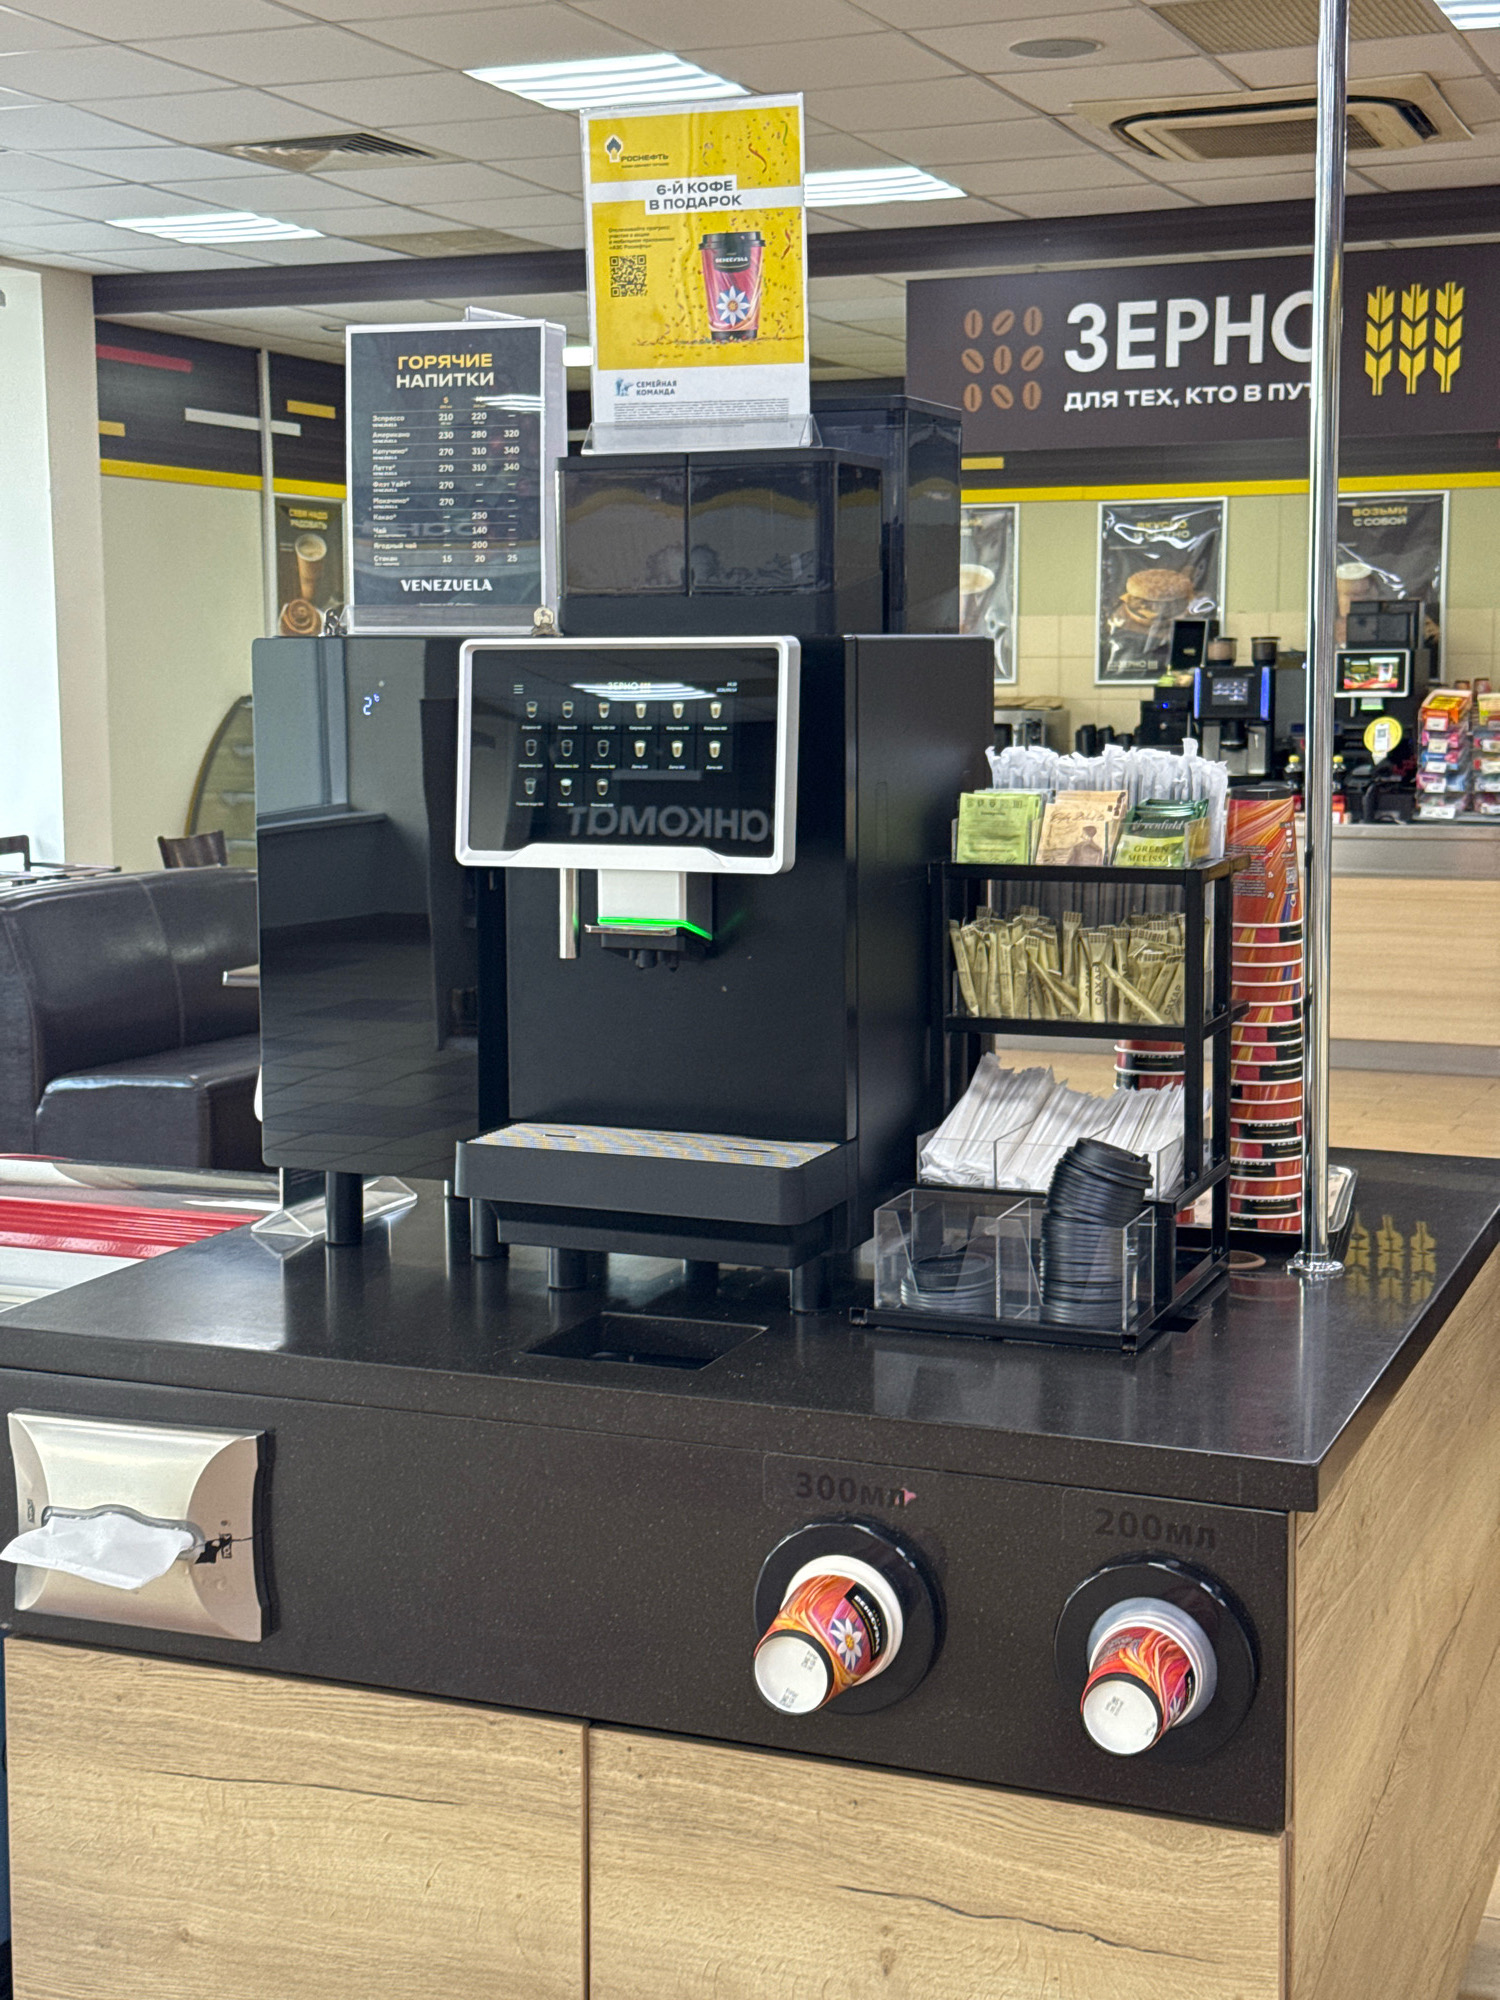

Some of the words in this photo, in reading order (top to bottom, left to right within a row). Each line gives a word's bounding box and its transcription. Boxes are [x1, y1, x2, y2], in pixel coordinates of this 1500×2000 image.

[621, 154, 669, 162] РОСНЕФТЬ
[656, 181, 684, 195] 6-Й
[687, 180, 733, 193] КОФЕ
[649, 199, 660, 210] В
[663, 195, 742, 209] ПОДАРОК
[1063, 290, 1313, 374] ЗЕРНО
[398, 353, 493, 370] ГОРЯЧИЕ
[396, 372, 495, 388] НАПИТКИ
[636, 379, 677, 388] СЕМЕЙНАЯ
[636, 388, 676, 396] КОМАНДА
[1063, 391, 1118, 411] ДЛЯ
[1124, 388, 1179, 408] ТЕХ,
[1185, 385, 1238, 404] КТО
[1244, 384, 1262, 402] В
[438, 413, 453, 421] 210
[471, 412, 487, 420] 220
[438, 431, 454, 440] 230
[471, 430, 487, 438] 280
[503, 429, 520, 438] 320
[438, 448, 454, 456] 270
[471, 447, 487, 455] 310
[503, 446, 520, 454] 340
[438, 464, 454, 473] 270
[471, 463, 487, 472] 310
[503, 462, 520, 471] 340
[438, 481, 454, 490] 270
[438, 498, 454, 506] 270
[471, 512, 488, 520] 250
[1352, 506, 1408, 517] ВОЗЬМИ
[1353, 517, 1362, 526] С
[471, 526, 488, 535] 140
[471, 541, 488, 549] 200
[442, 555, 453, 563] 15
[474, 555, 486, 563] 20
[507, 554, 518, 562] 25
[400, 578, 493, 592] VENEZUELA
[1133, 845, 1170, 853] GREEN
[1128, 854, 1169, 862] MELISSA
[1095, 1508, 1216, 1549] 200мл
